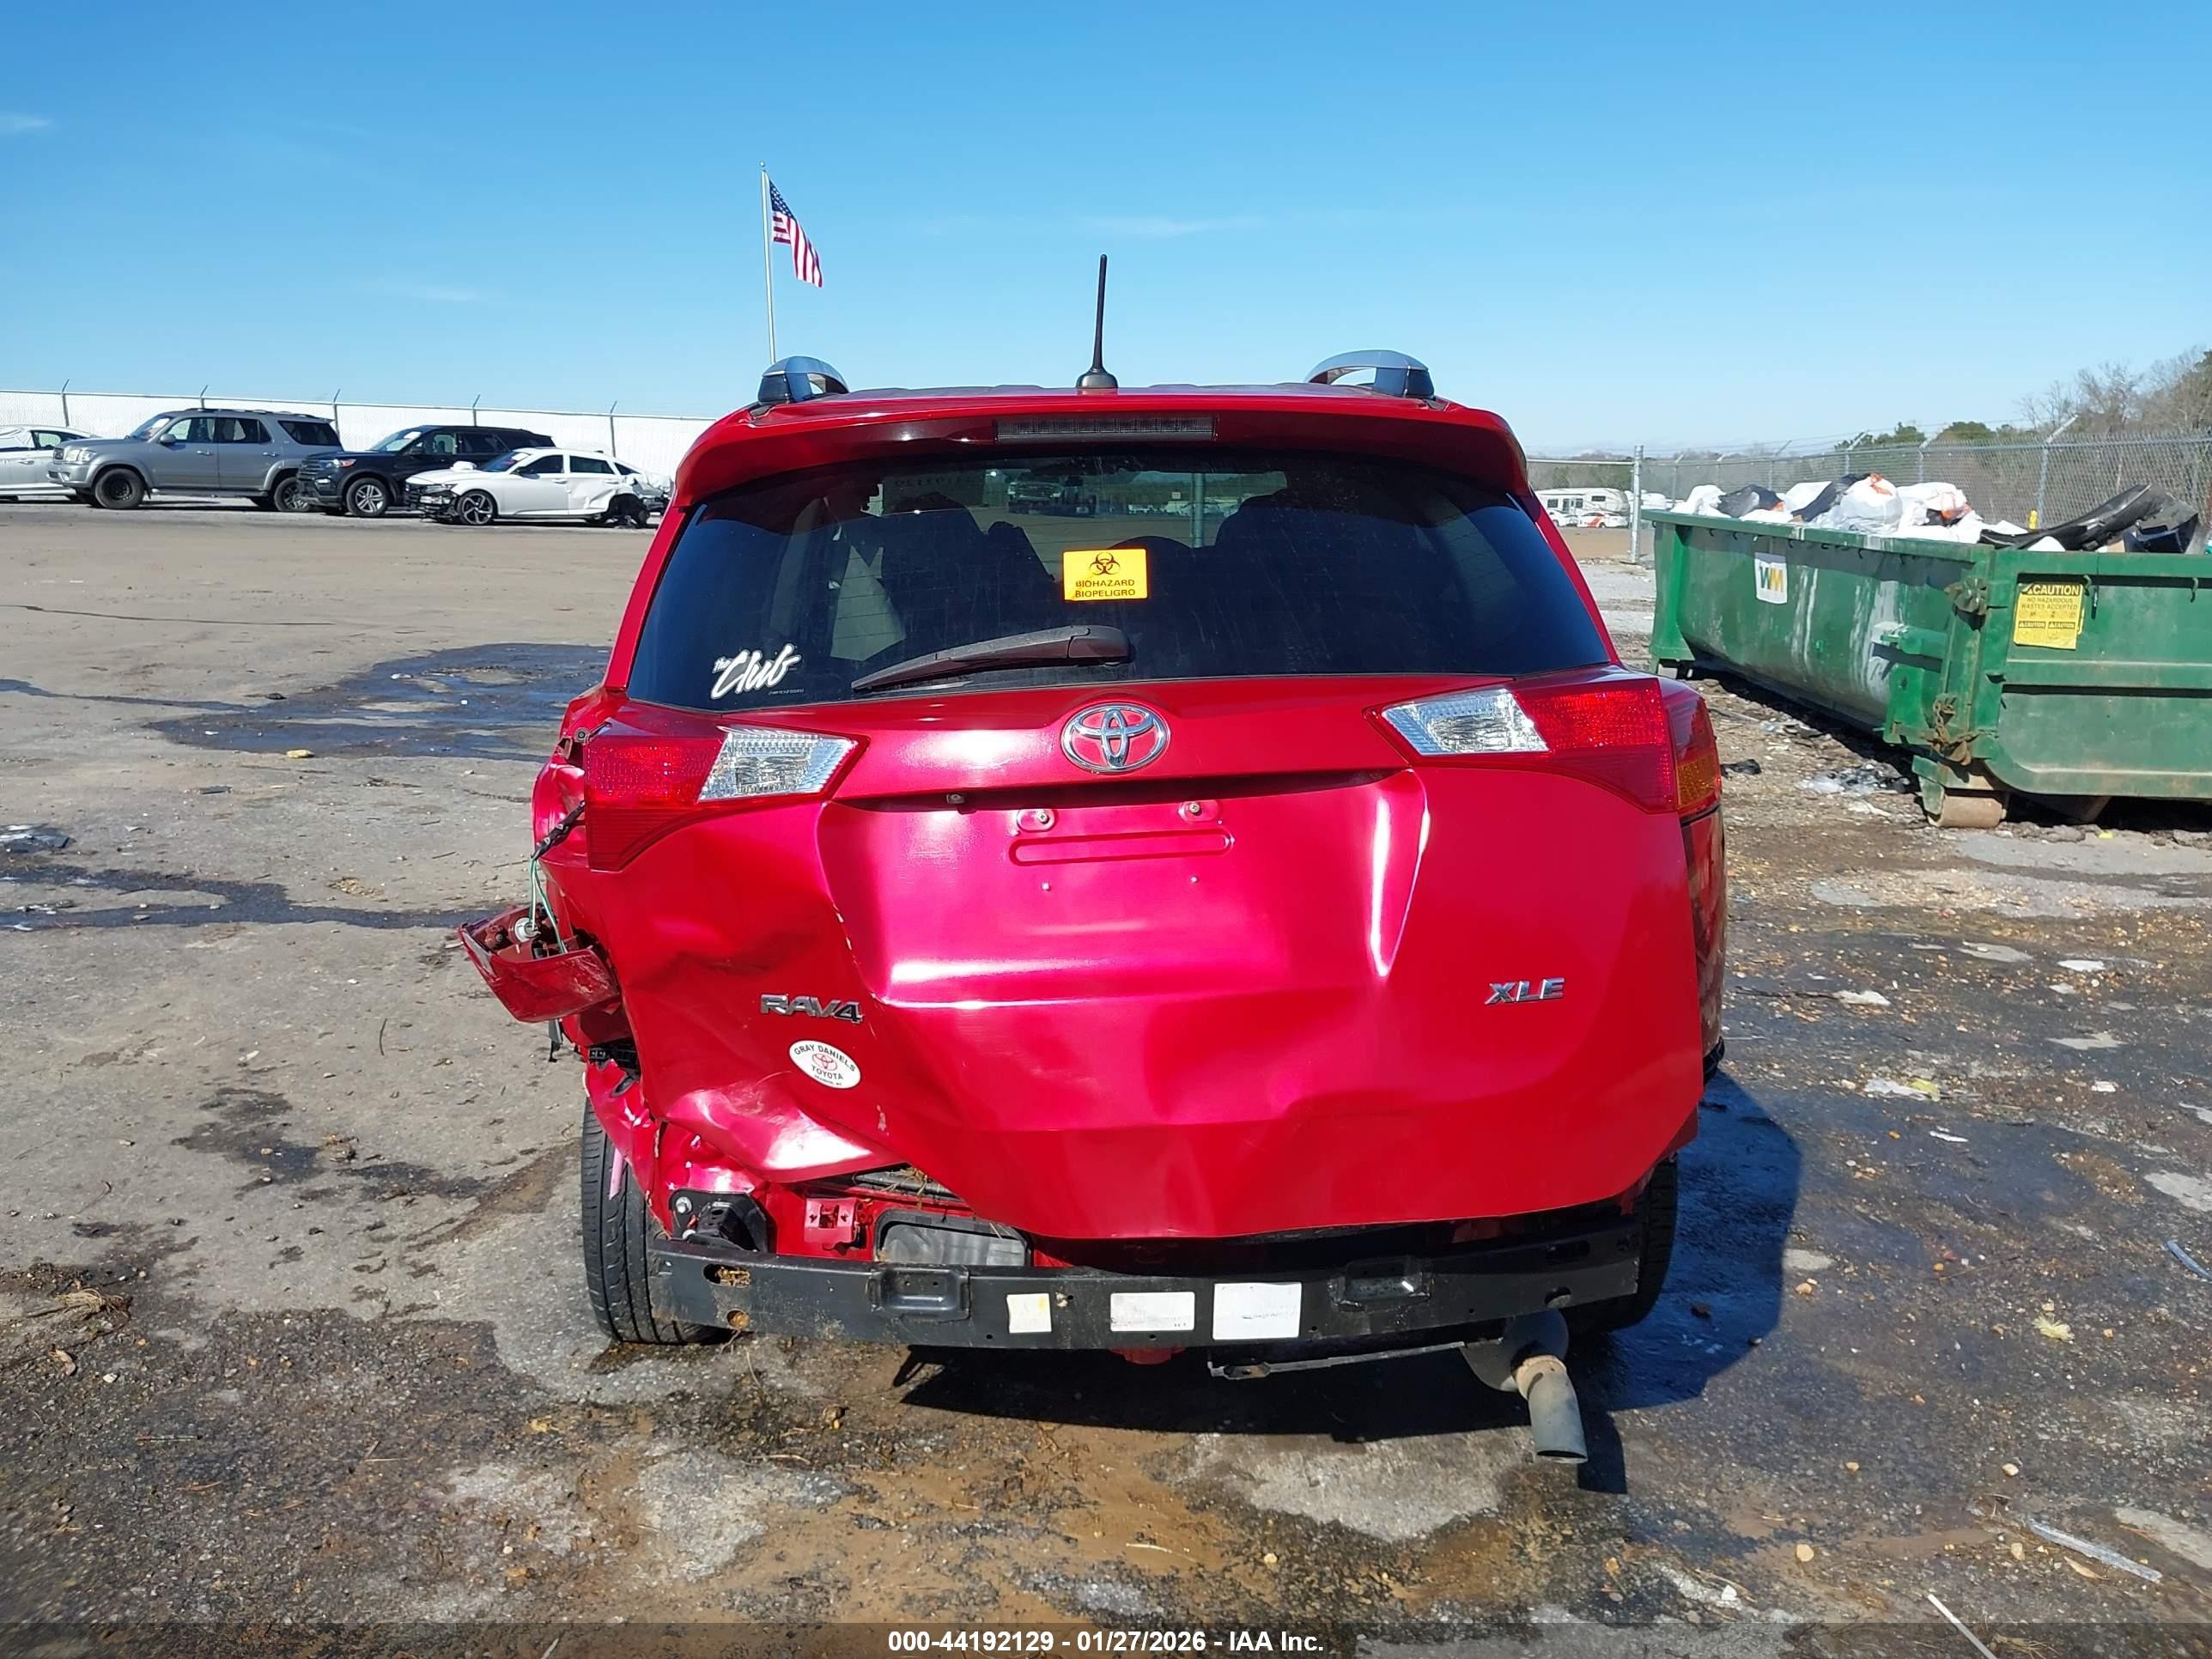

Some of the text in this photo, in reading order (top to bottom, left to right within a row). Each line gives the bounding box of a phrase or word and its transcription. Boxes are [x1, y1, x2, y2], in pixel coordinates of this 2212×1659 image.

[1075, 579, 1135, 587] BIOHAZARD
[1759, 566, 1784, 592] WM
[2033, 584, 2079, 595] CAUTION
[1074, 588, 1136, 599] BIOPELIGRO
[1484, 977, 1565, 1005] XLE
[761, 994, 865, 1024] RAV4
[793, 1043, 856, 1072] GRAY DANIELS
[811, 1064, 844, 1080] TOYOTA
